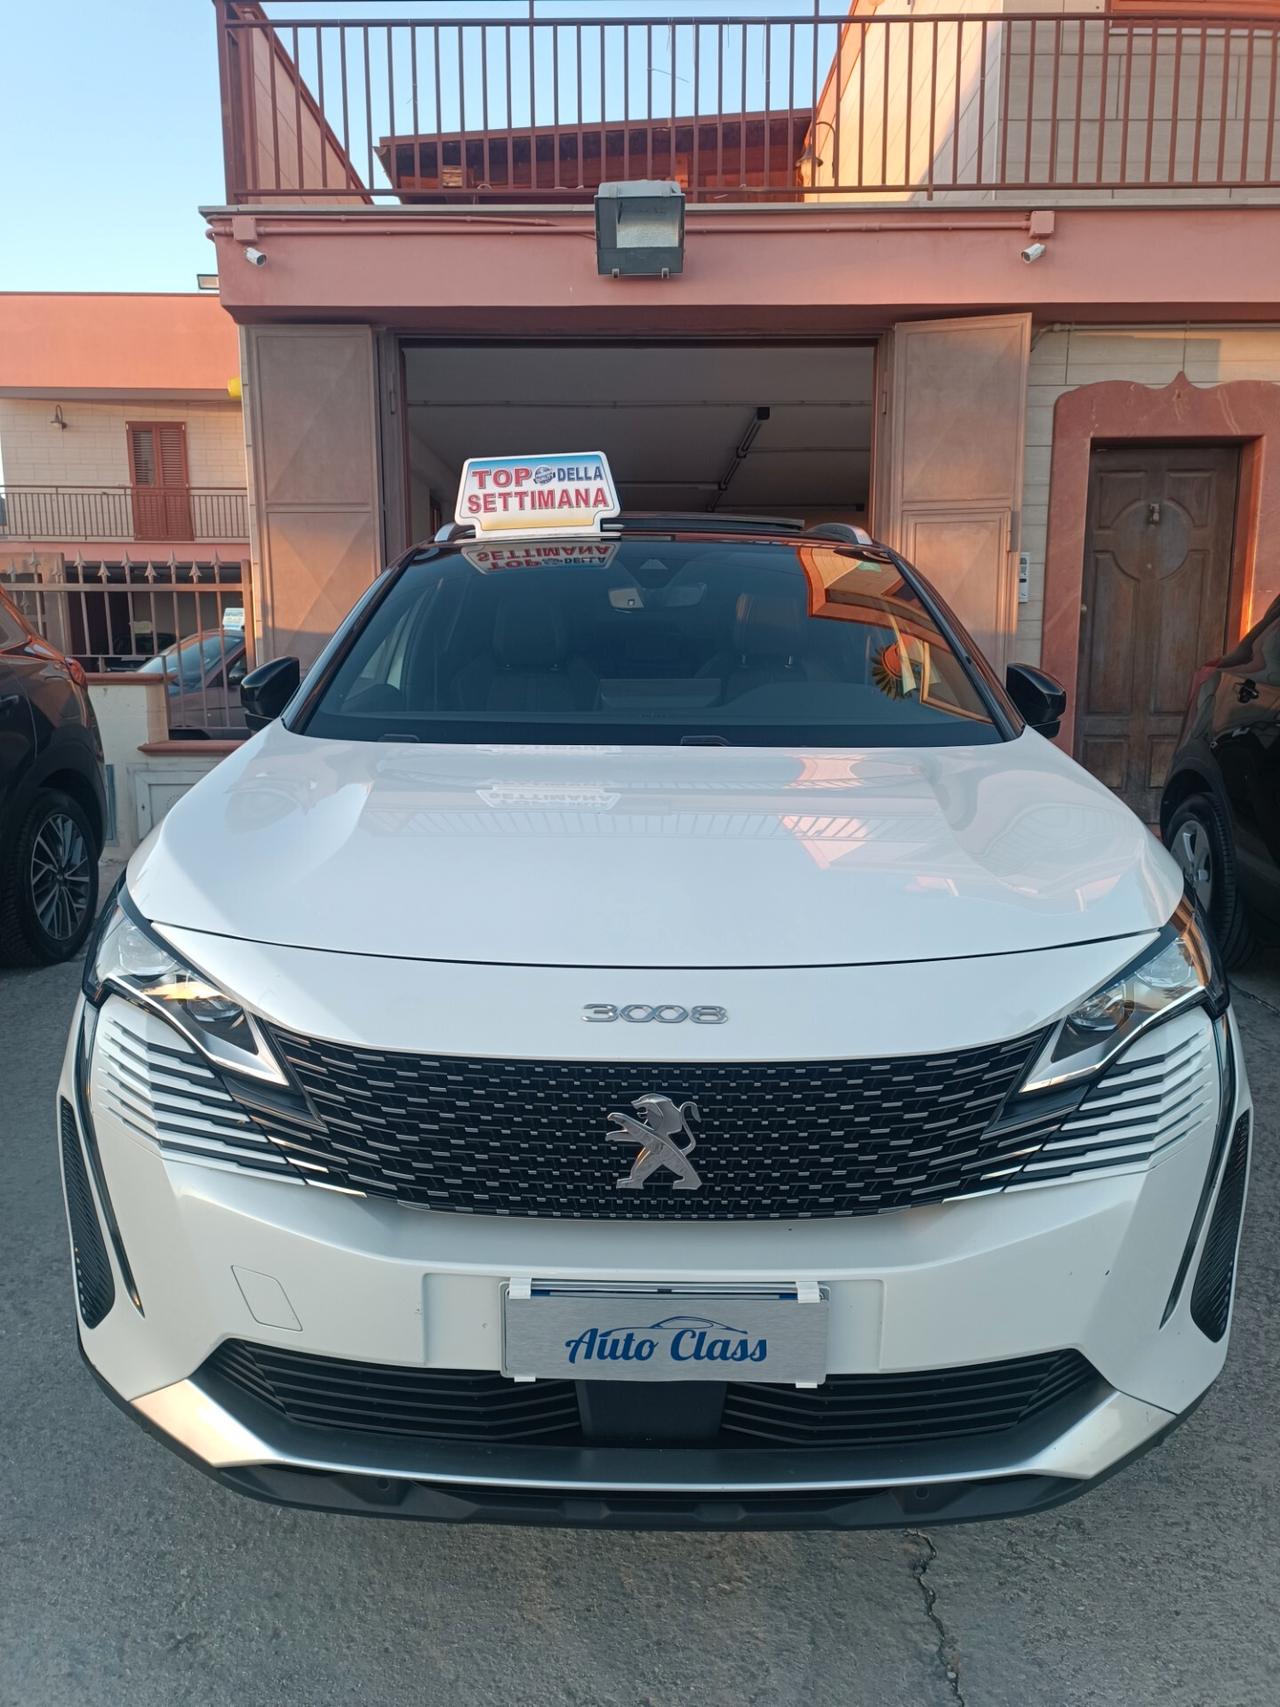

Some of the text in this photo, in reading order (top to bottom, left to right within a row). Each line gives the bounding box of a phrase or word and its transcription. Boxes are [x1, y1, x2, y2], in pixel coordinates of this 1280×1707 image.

[472, 468, 532, 490] TOP
[557, 466, 604, 482] DELLA
[467, 487, 610, 514] SETTIMANA
[581, 1003, 729, 1024] 3008
[565, 1327, 767, 1364] Auto Class
